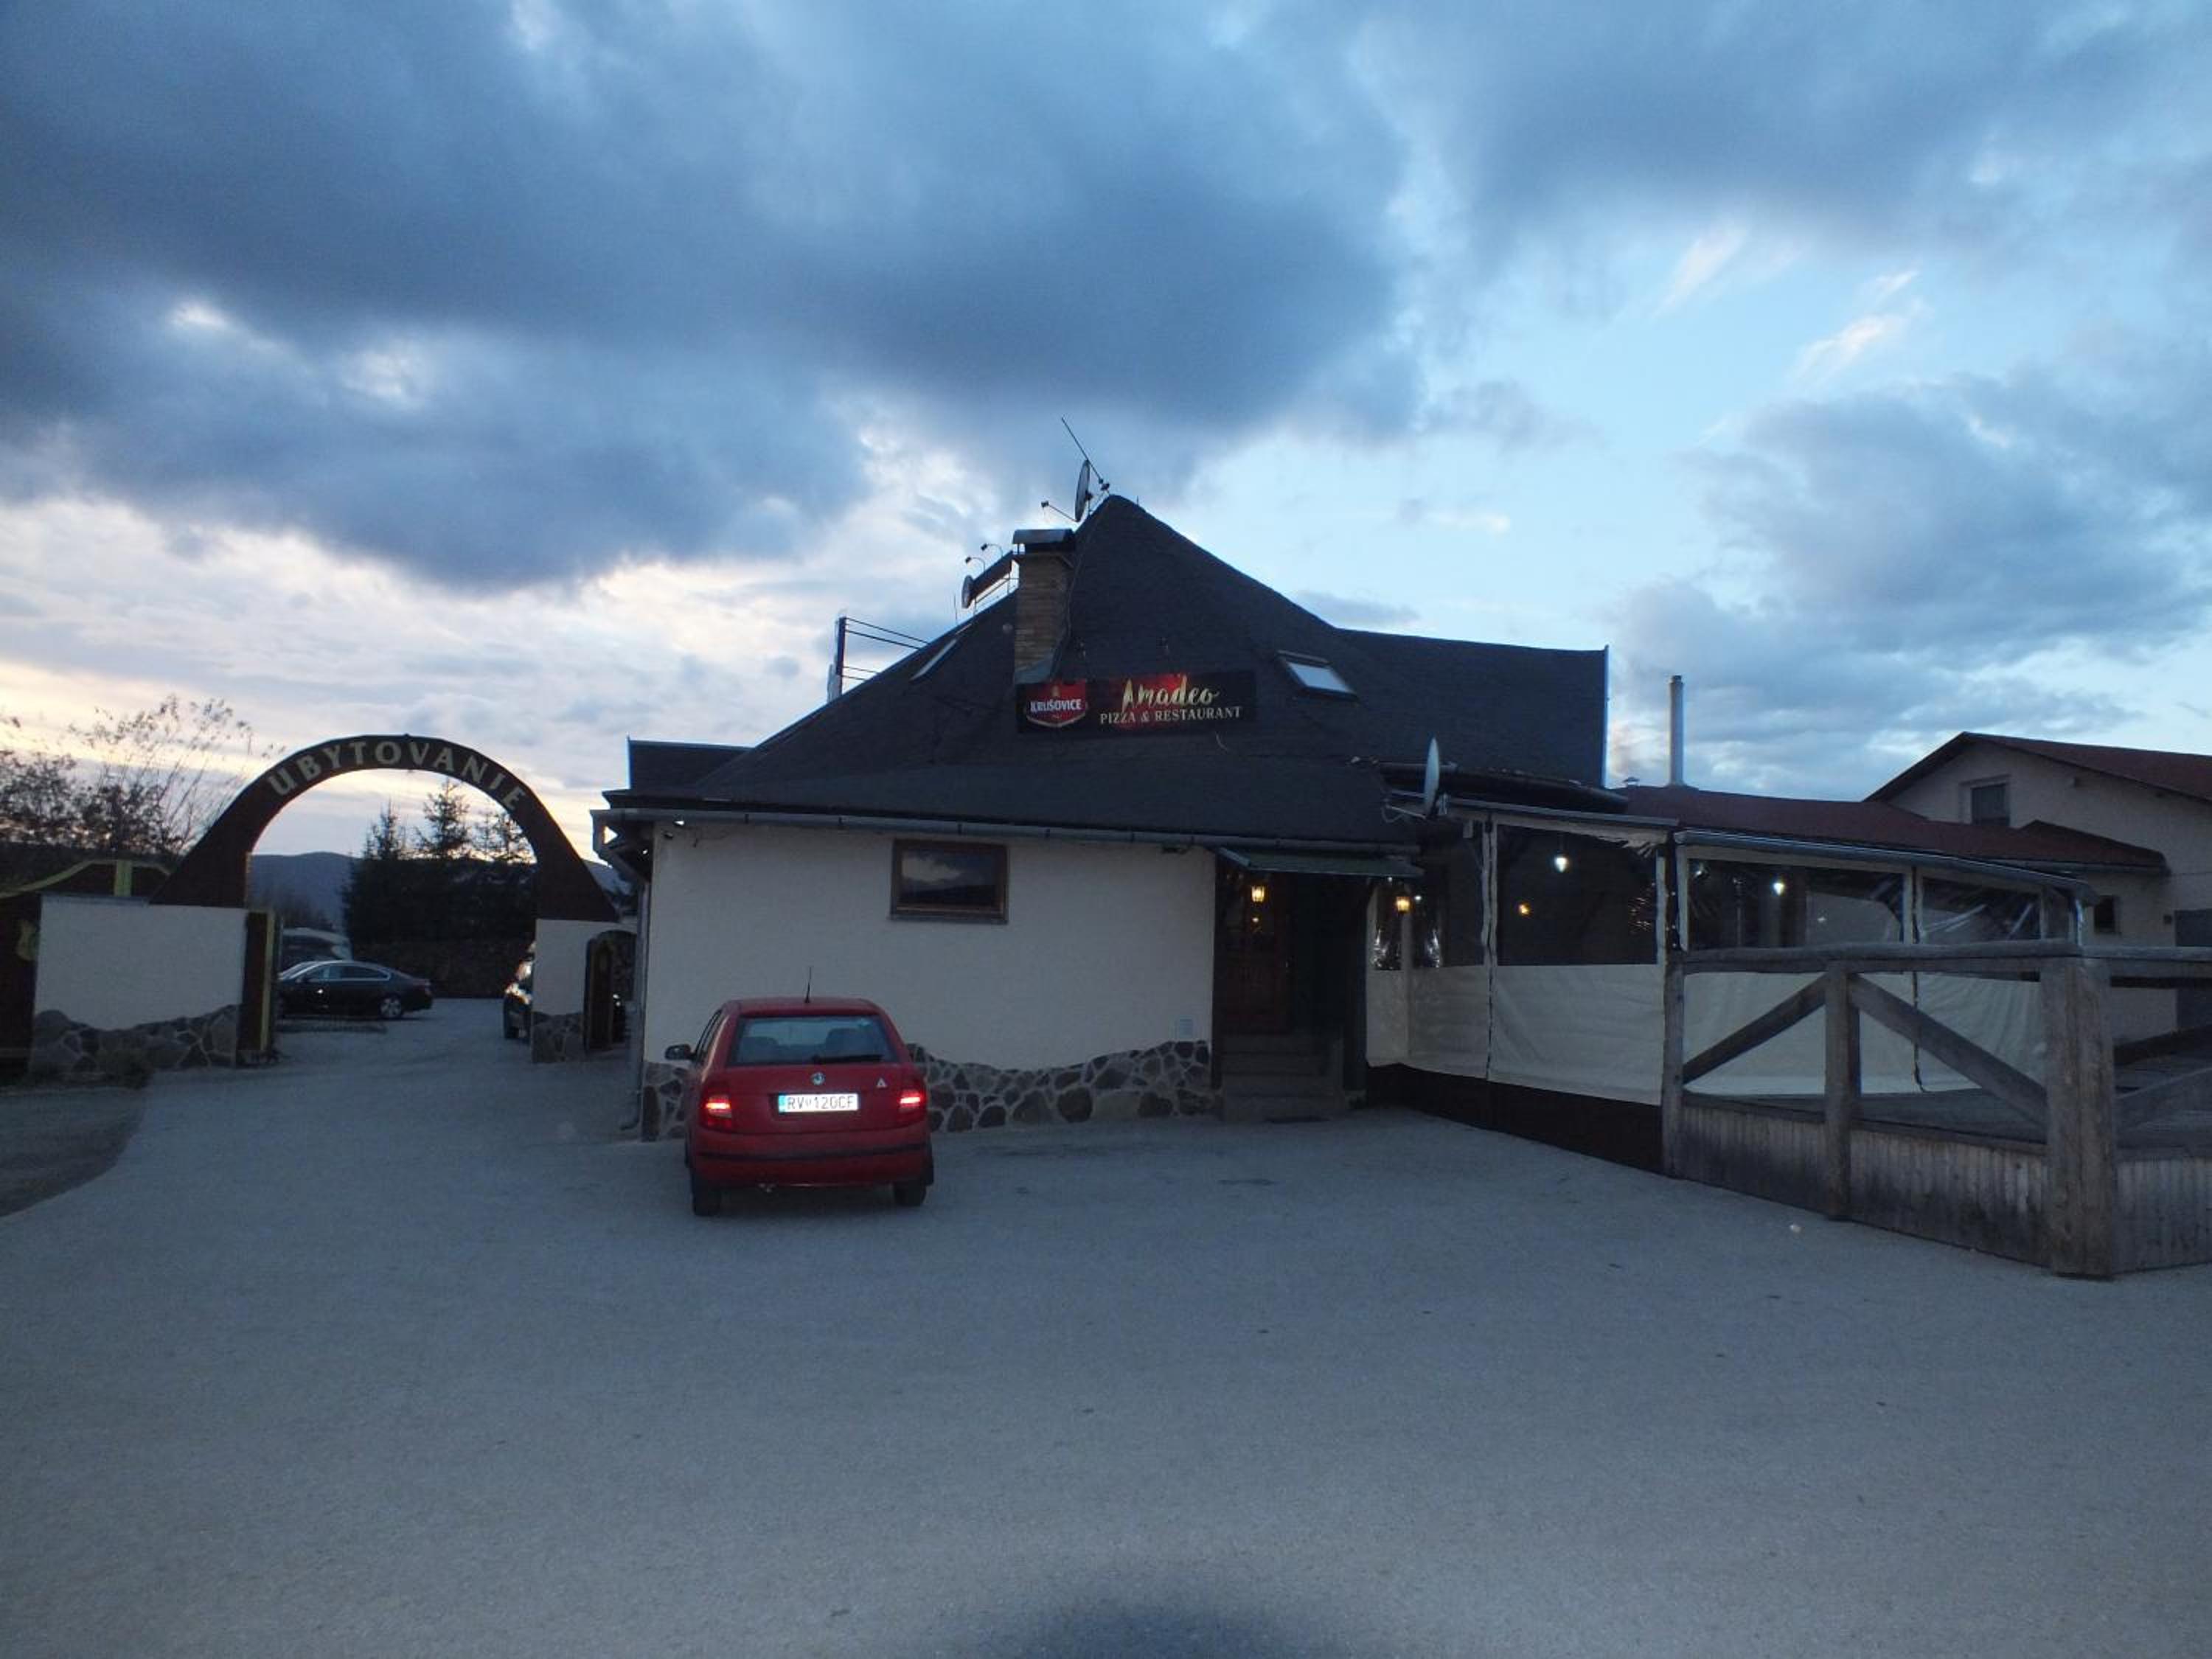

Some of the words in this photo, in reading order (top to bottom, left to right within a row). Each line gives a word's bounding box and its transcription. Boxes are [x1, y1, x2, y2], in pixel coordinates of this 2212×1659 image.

[1121, 674, 1220, 712] Amadeo
[1100, 711, 1135, 725] PIZZA
[1141, 712, 1150, 723] &
[1155, 706, 1242, 722] RESTAURANT
[267, 741, 526, 810] UBYTOVANIE
[787, 1096, 804, 1110] RV
